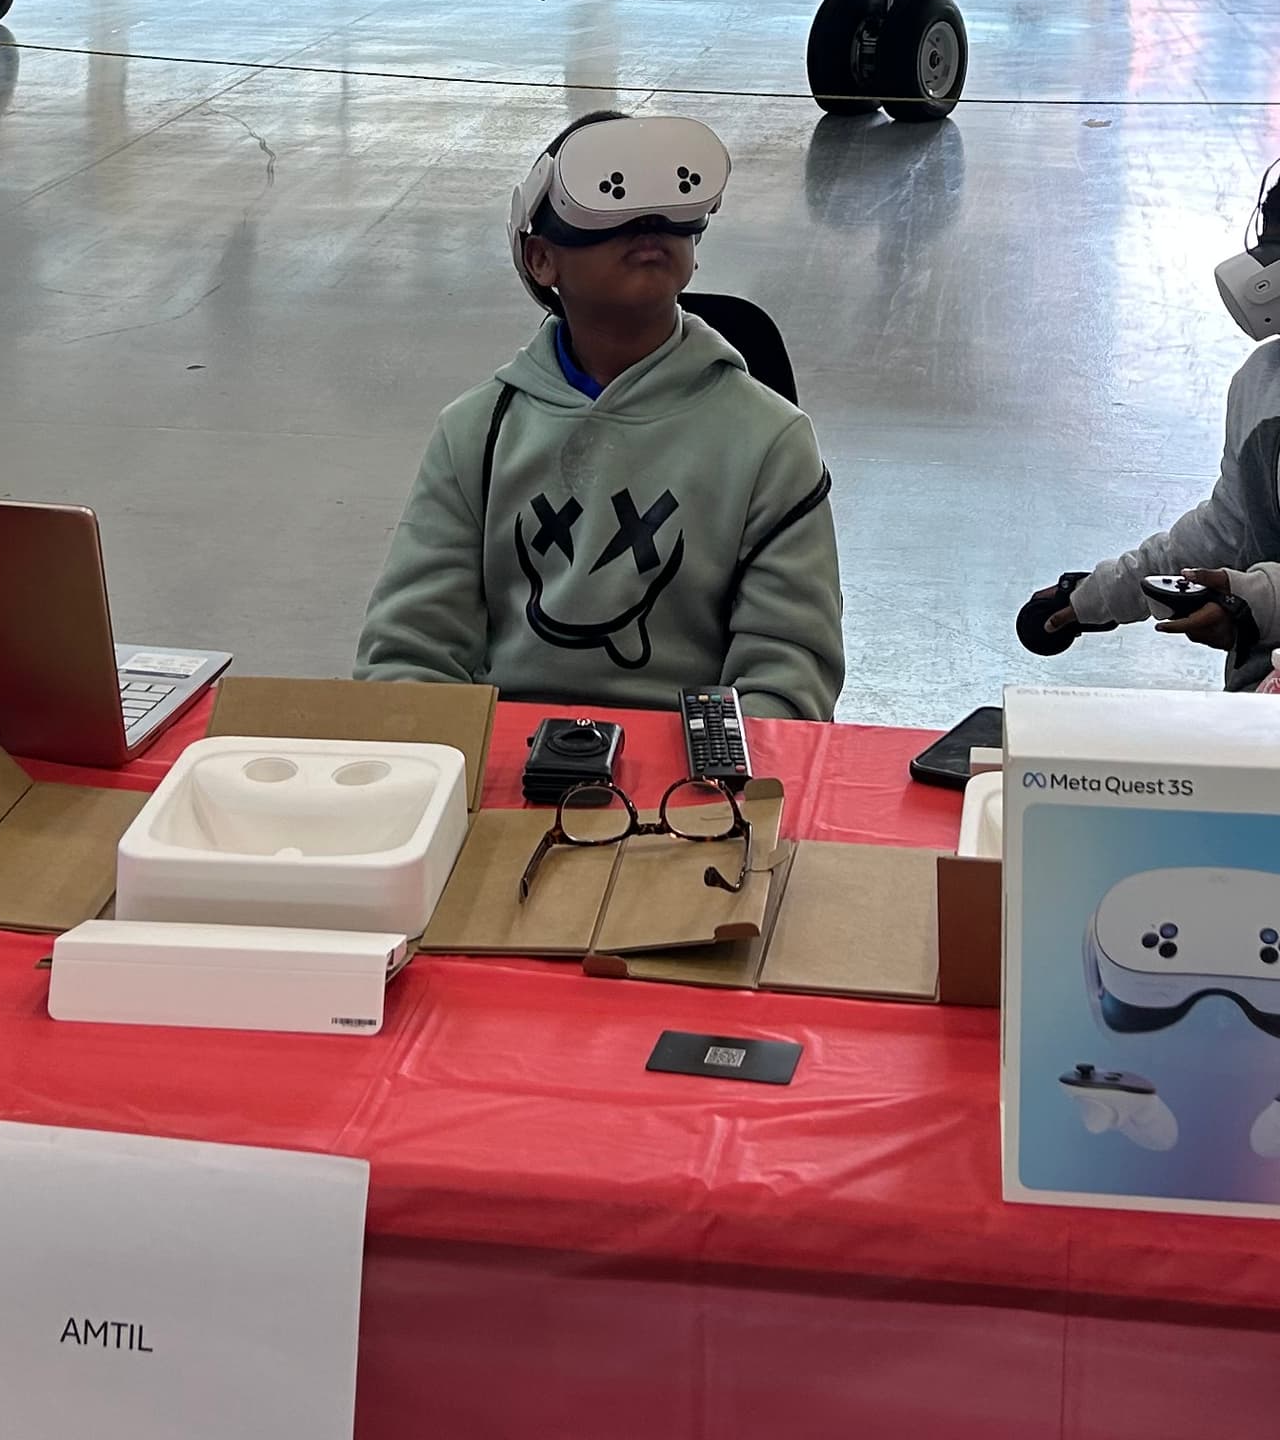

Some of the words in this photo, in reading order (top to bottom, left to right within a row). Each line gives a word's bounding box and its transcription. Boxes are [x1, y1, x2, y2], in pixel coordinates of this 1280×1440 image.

[1050, 773, 1101, 792] Meta
[1105, 776, 1165, 795] Quest
[1168, 779, 1193, 796] 3S
[60, 1317, 153, 1352] AMTIL
